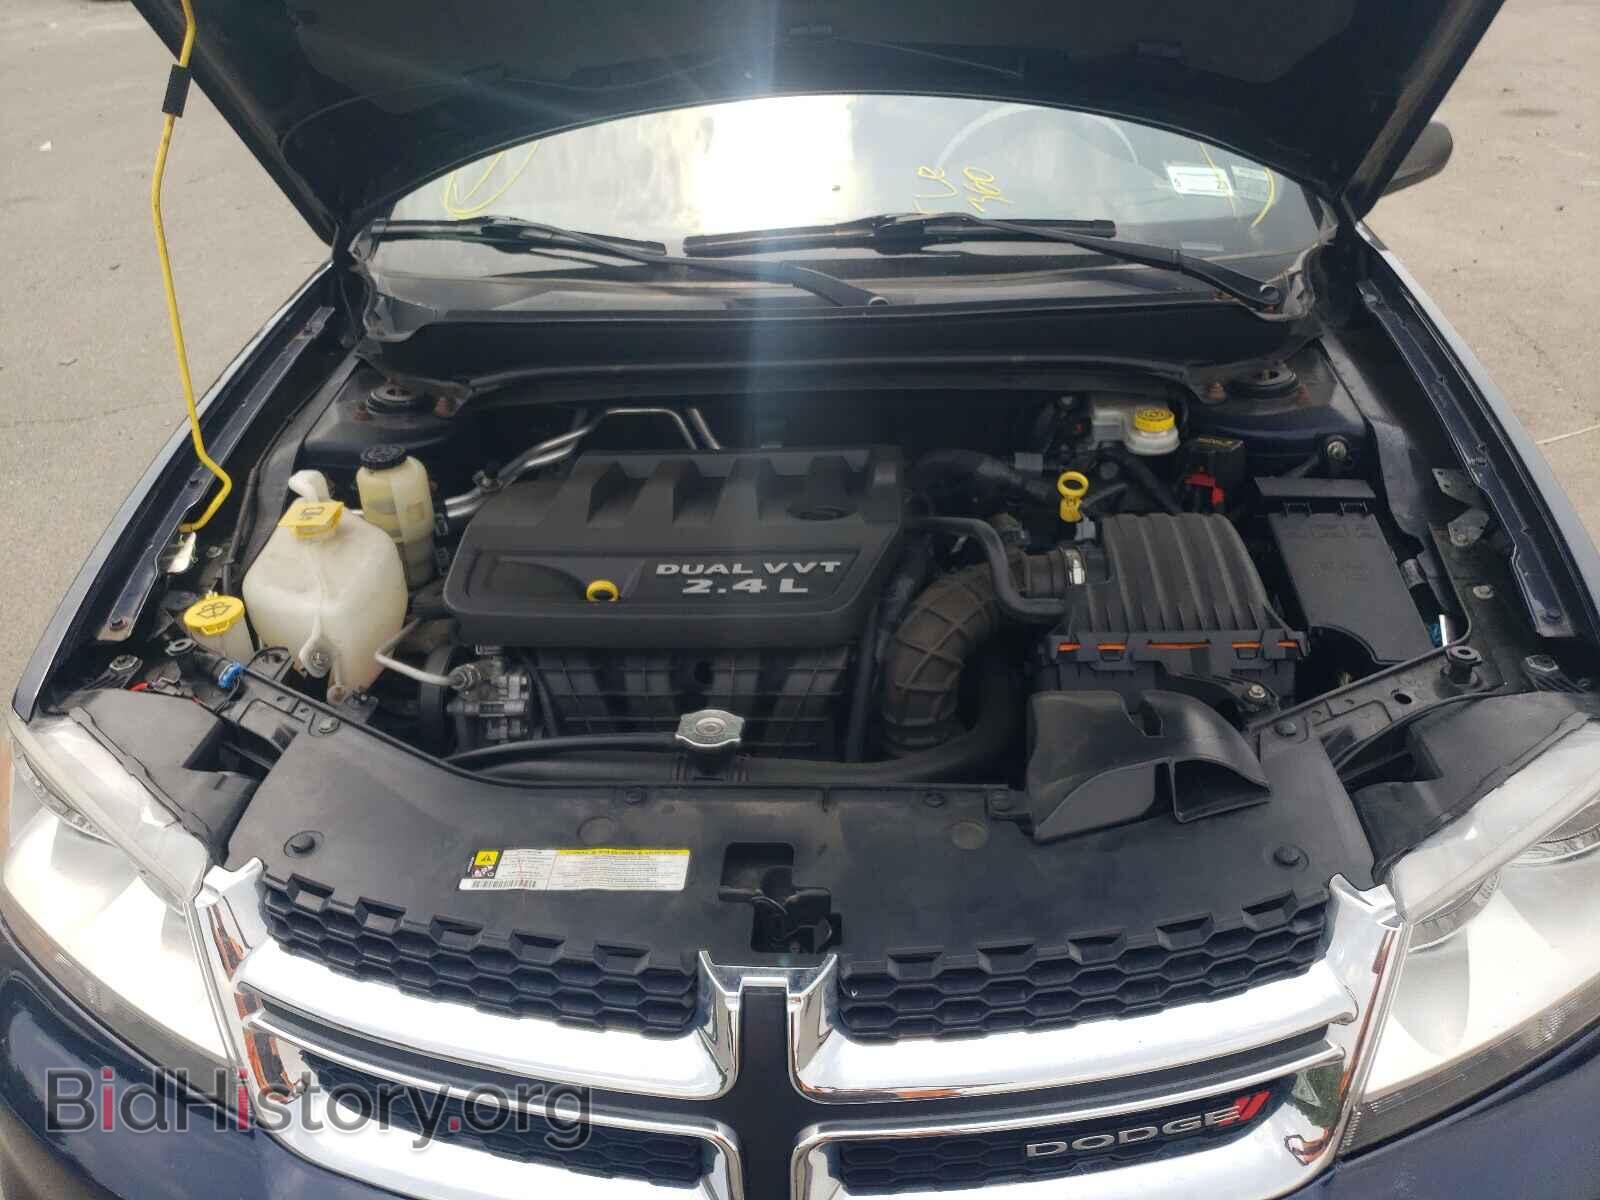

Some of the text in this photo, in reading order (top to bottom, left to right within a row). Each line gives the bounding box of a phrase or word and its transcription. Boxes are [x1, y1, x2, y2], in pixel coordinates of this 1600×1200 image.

[655, 561, 841, 575] DUAL VVT
[1026, 1105, 1241, 1158] DODGE
